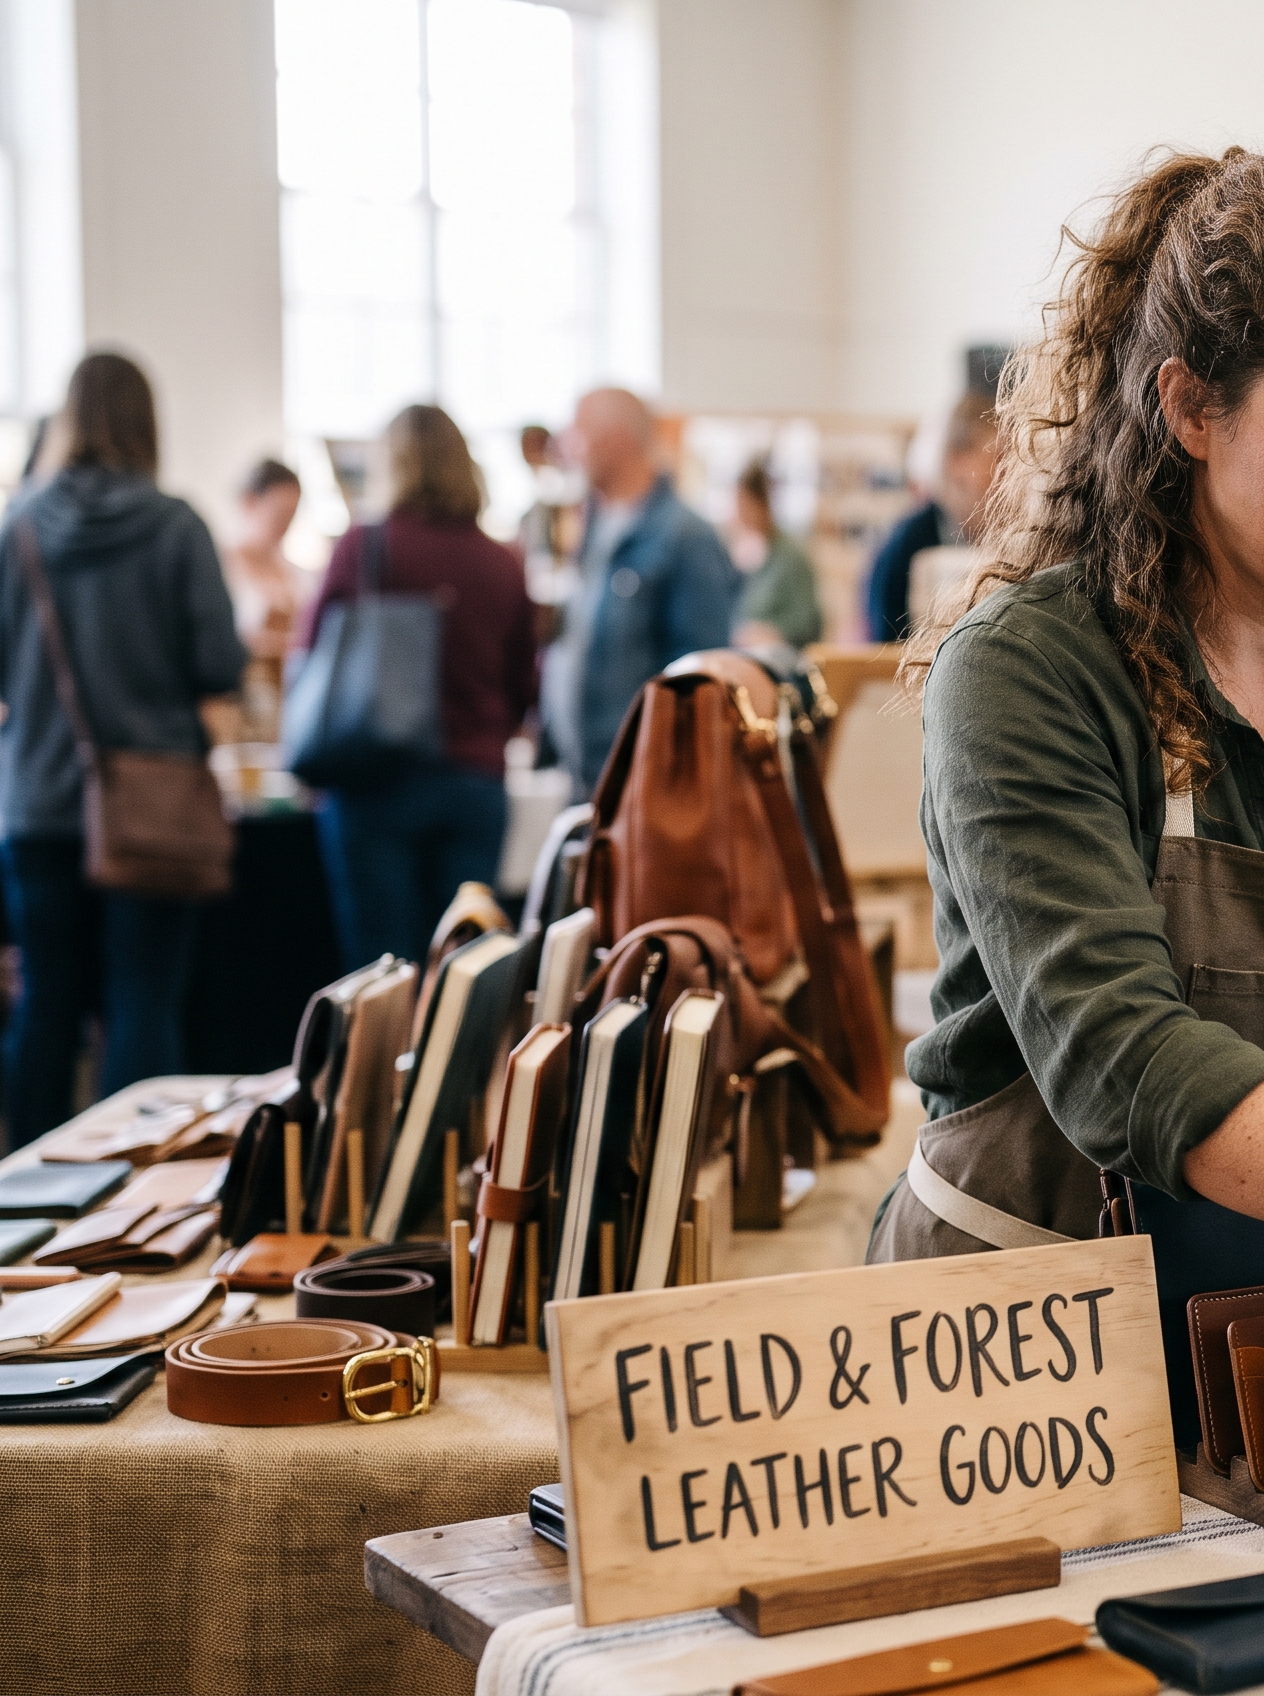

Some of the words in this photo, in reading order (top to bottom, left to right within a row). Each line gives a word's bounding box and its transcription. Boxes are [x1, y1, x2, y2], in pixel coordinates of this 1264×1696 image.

[615, 1333, 802, 1445] FIELD
[829, 1325, 871, 1410] &
[890, 1286, 1115, 1405] FOREST
[640, 1436, 917, 1552] LEATHER
[939, 1406, 1116, 1506] GOODS
